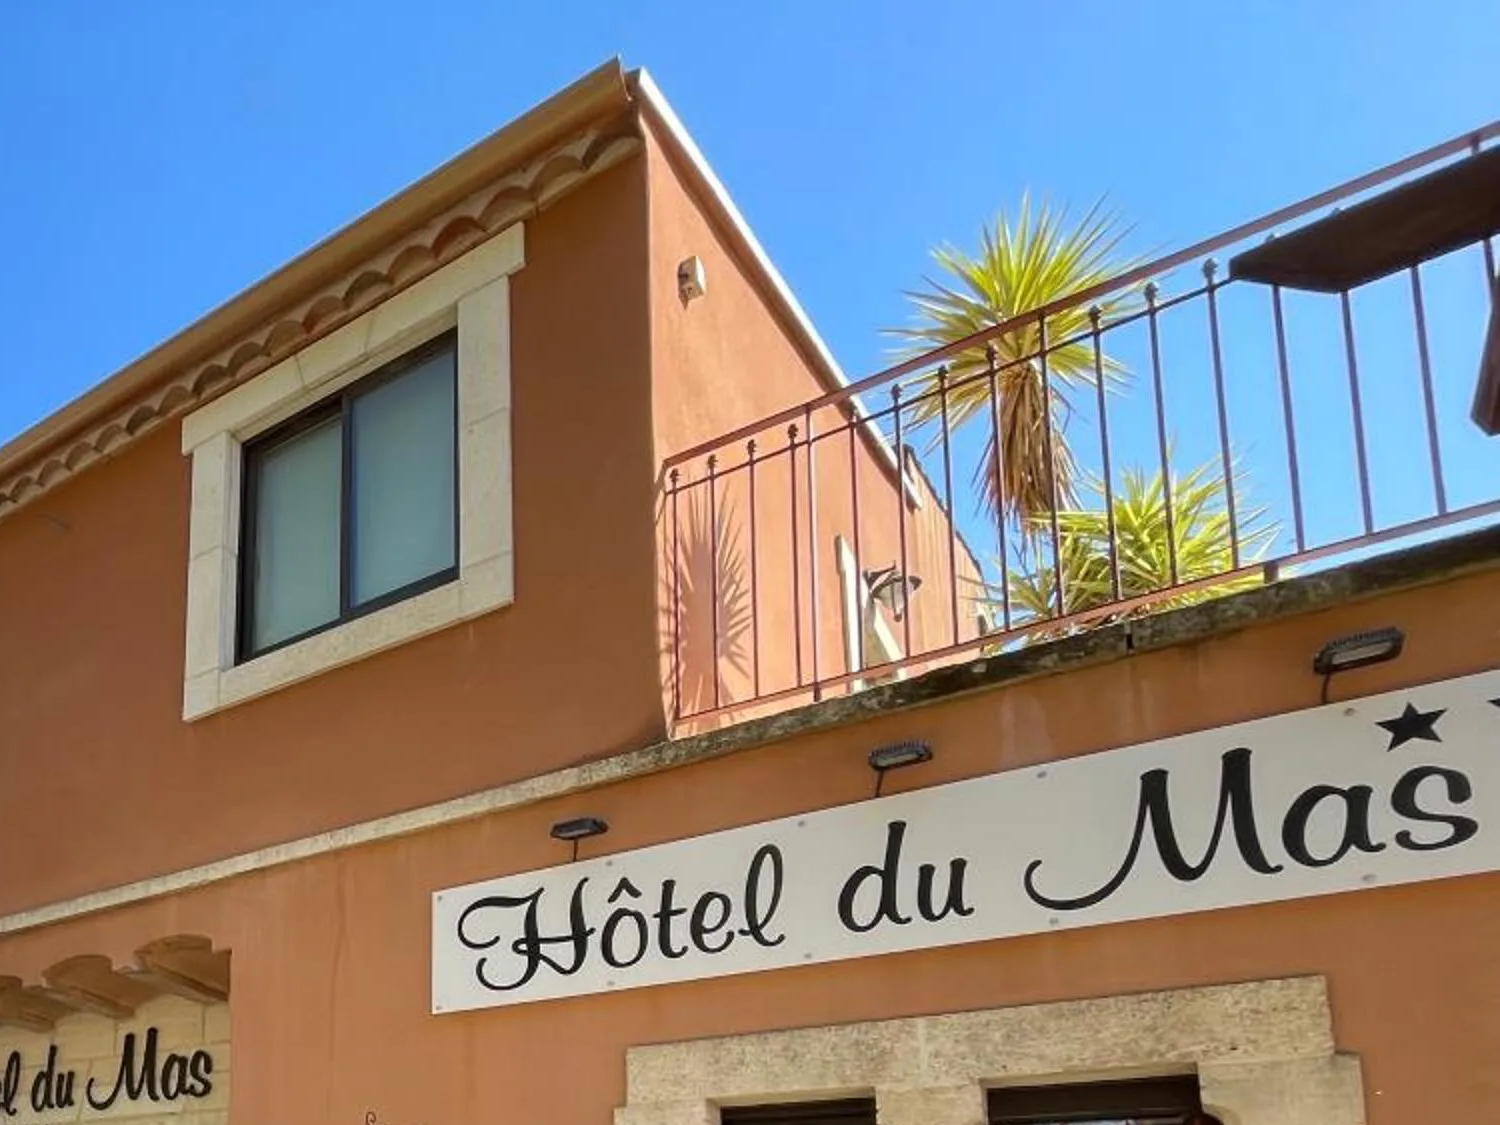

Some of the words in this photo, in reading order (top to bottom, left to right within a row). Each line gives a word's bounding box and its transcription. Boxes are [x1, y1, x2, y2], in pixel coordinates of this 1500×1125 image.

[456, 843, 786, 992] Hôtel
[836, 819, 975, 933] du
[1023, 747, 1480, 912] Mas
[31, 1044, 76, 1113] du
[86, 1026, 214, 1111] Mas
